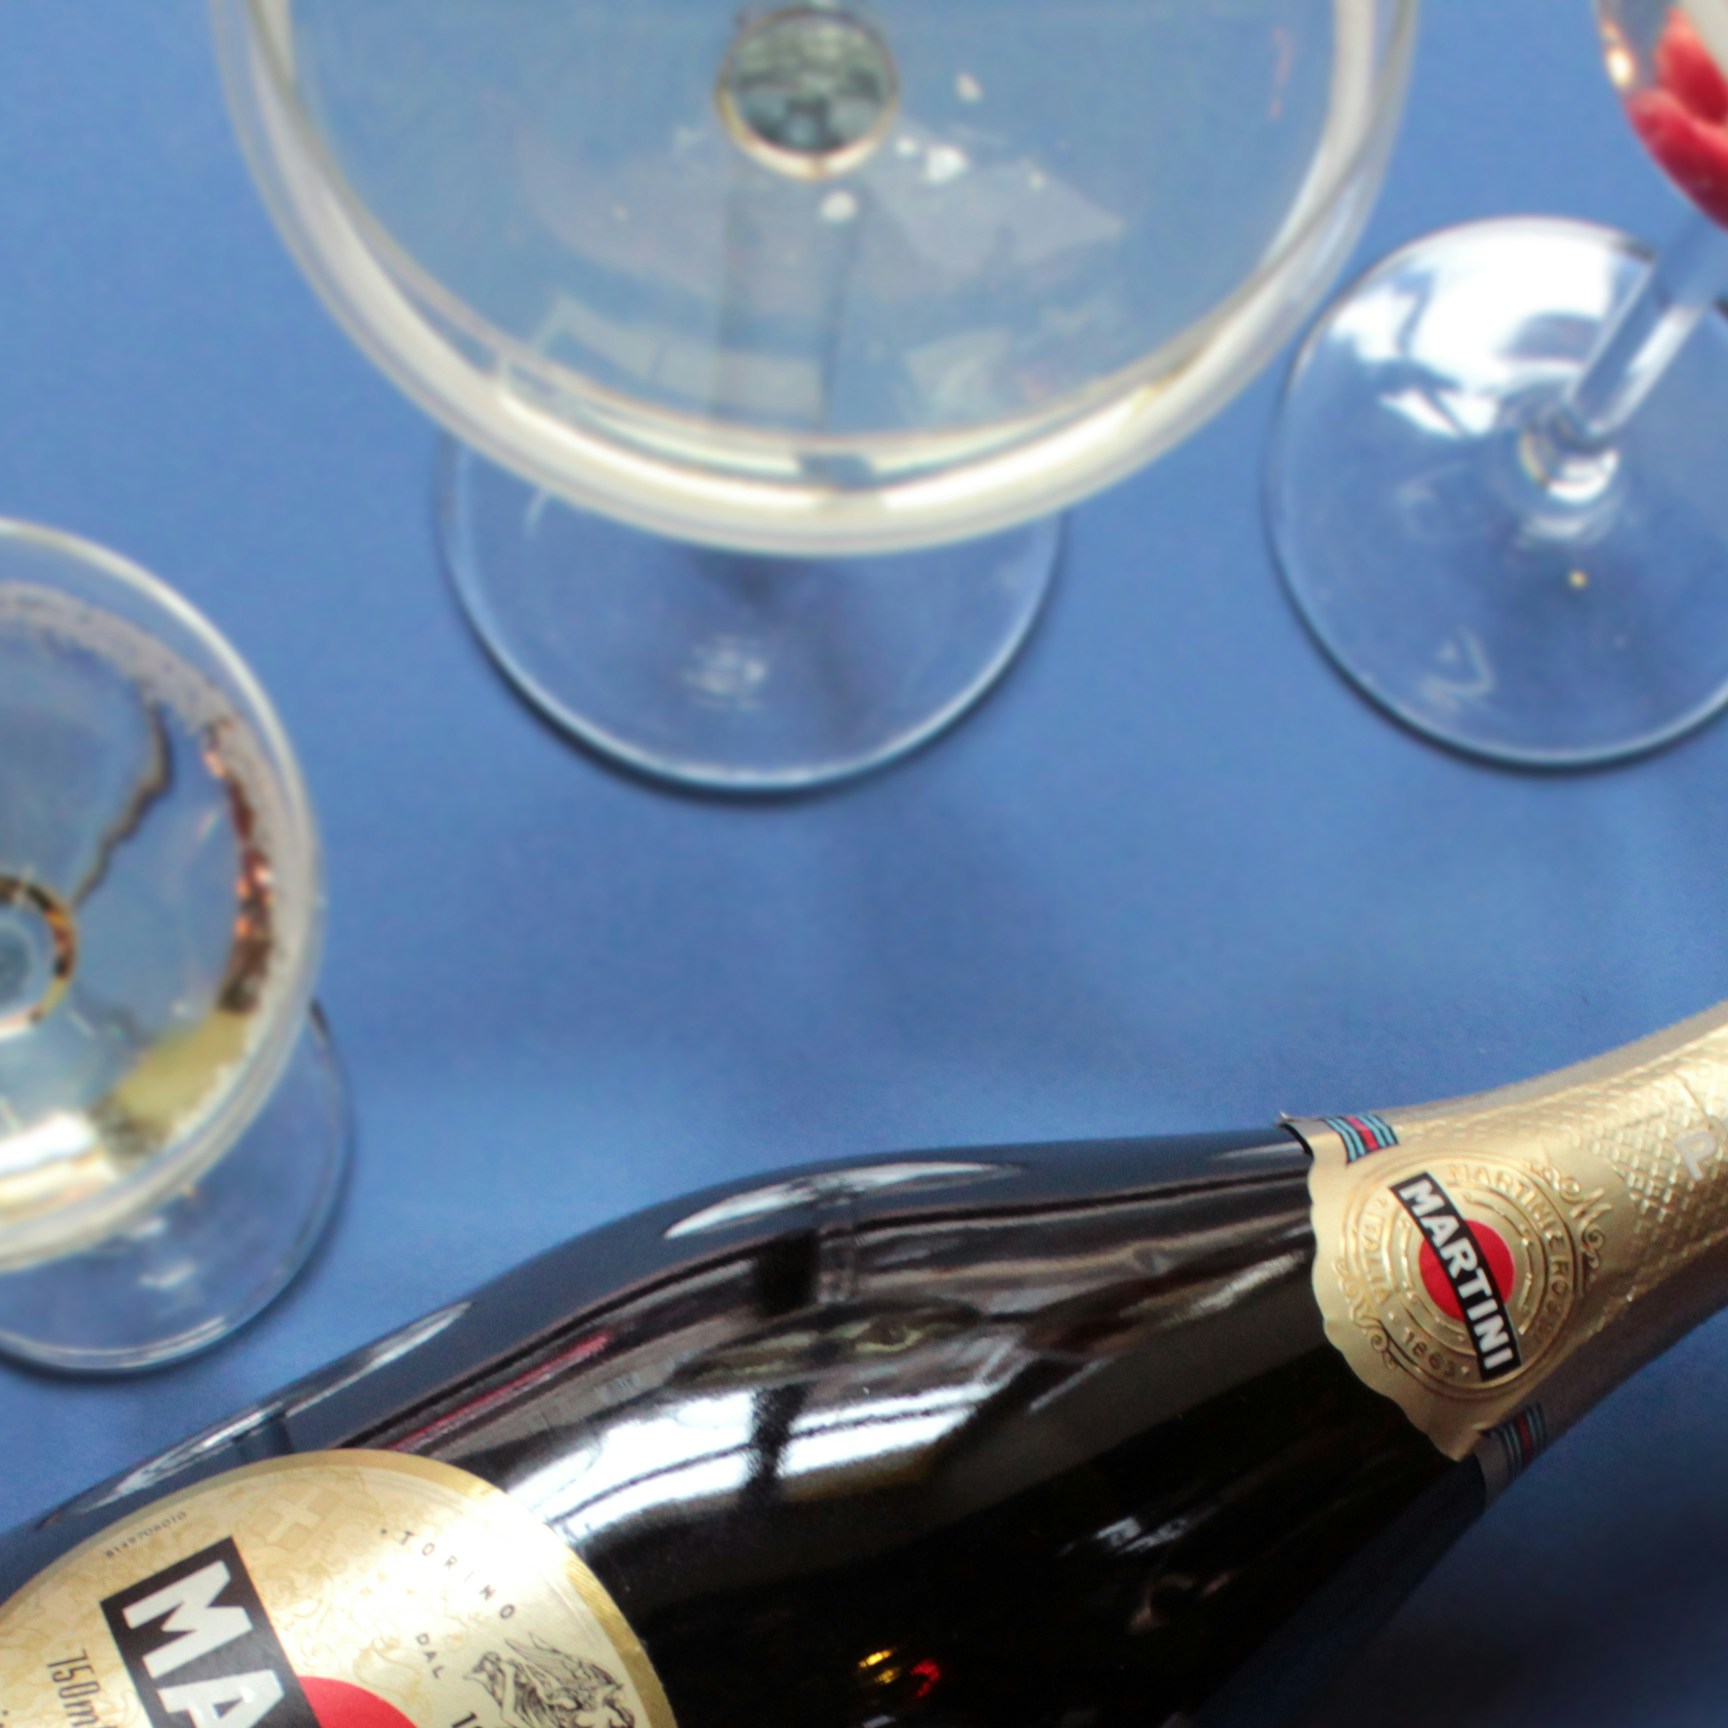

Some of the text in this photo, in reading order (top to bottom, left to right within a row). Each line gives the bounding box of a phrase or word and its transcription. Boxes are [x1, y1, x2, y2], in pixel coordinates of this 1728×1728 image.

[1399, 1179, 1514, 1370] MARTINI
[400, 1530, 515, 1621] TORINO
[416, 1632, 445, 1680] DAL
